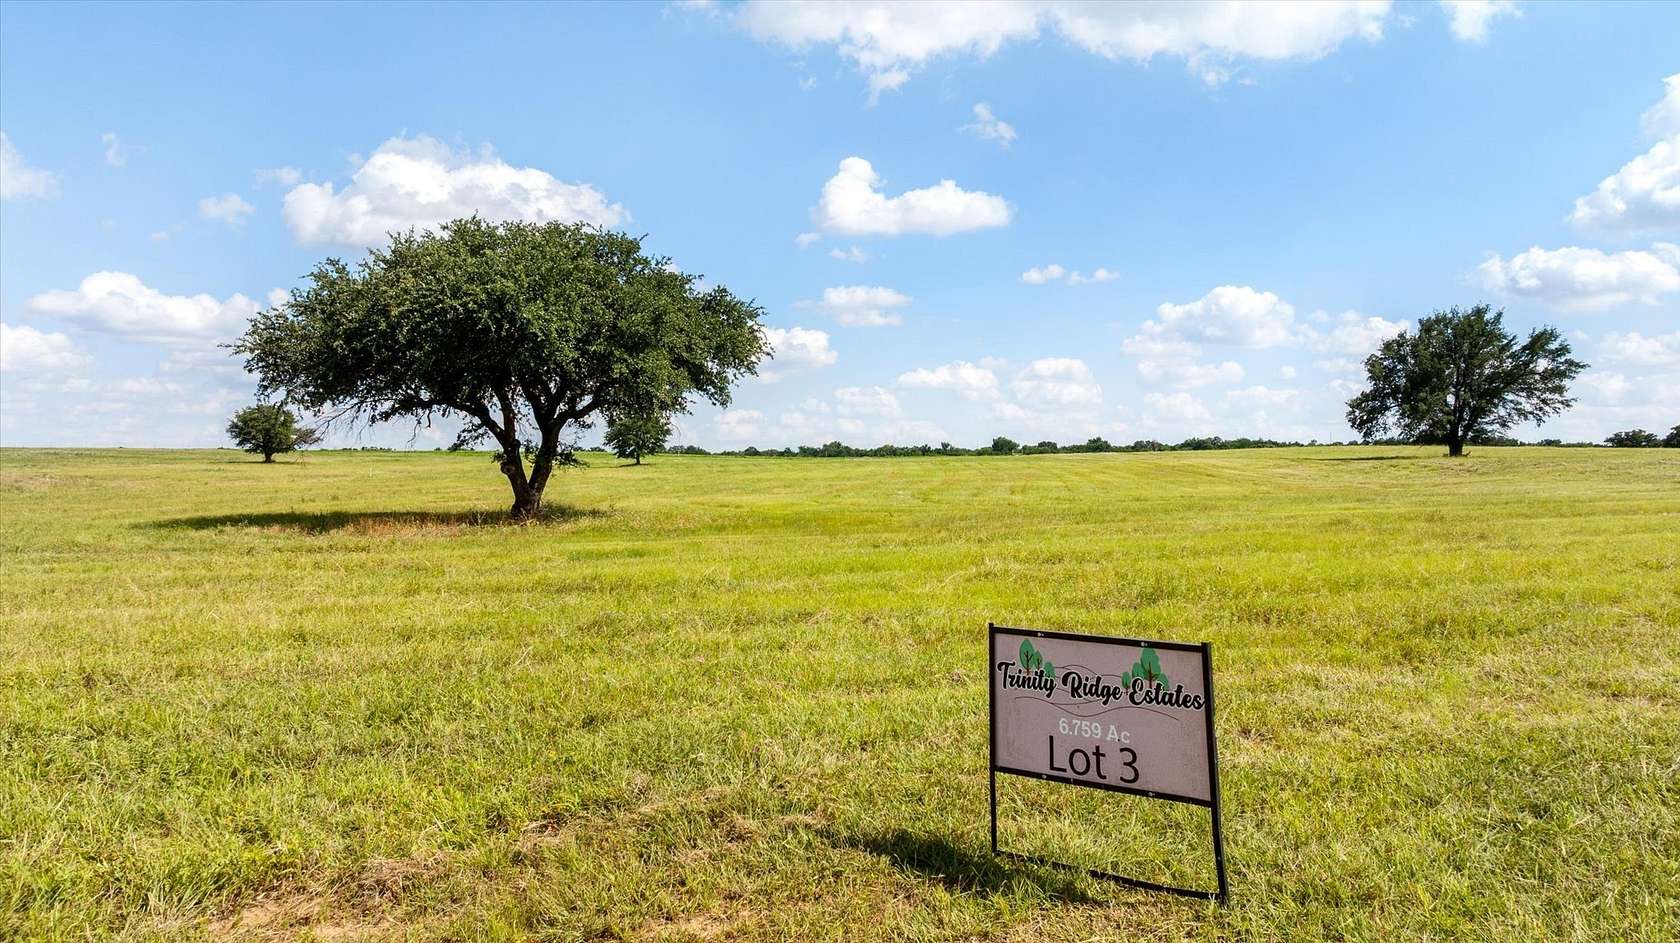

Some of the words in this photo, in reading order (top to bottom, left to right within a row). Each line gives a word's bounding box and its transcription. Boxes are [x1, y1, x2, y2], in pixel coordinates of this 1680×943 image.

[997, 661, 1056, 698] Trinity
[1062, 671, 1122, 705] Ridge
[1129, 678, 1205, 710] Estates
[1059, 718, 1101, 738] 6.759
[1049, 735, 1107, 780] Lot
[1119, 747, 1140, 784] 3
